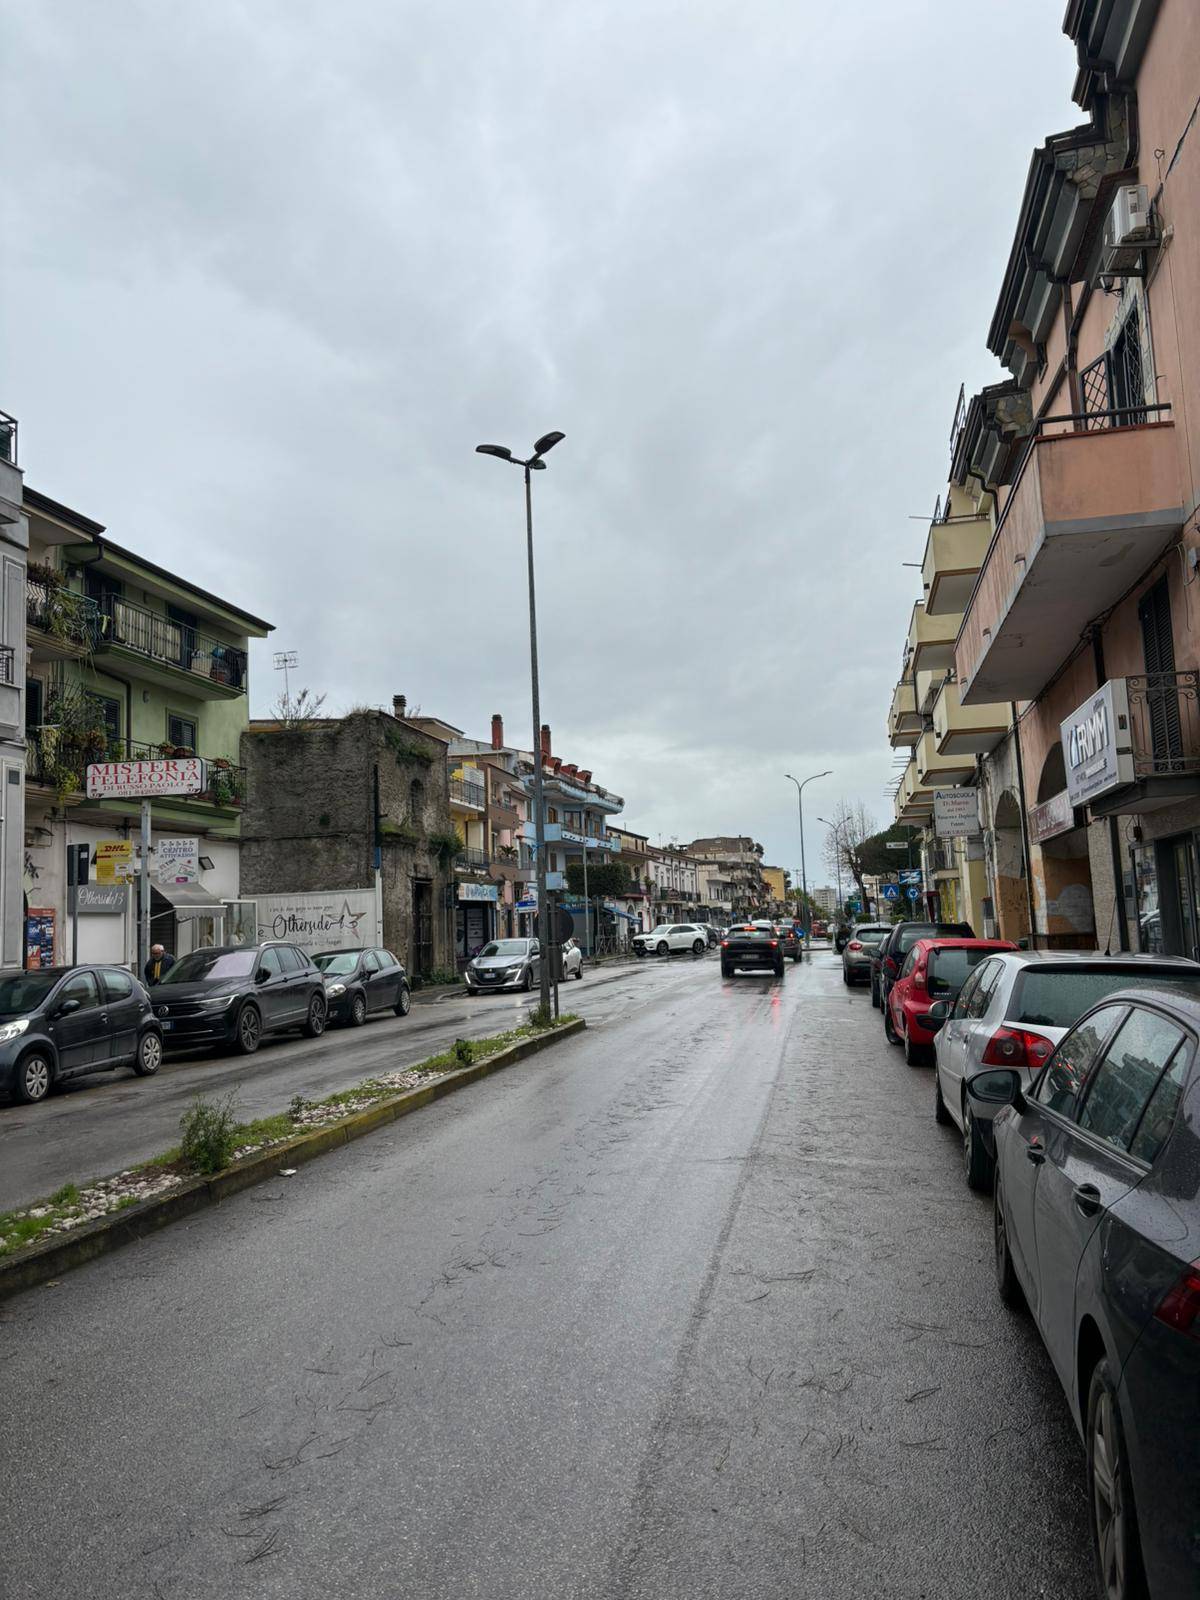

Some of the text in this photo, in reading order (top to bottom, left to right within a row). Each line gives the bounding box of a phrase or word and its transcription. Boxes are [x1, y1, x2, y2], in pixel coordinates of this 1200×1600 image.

[92, 760, 197, 776] MISTER 3
[90, 771, 199, 786] TELEFONIA
[117, 782, 147, 790] RUSSO
